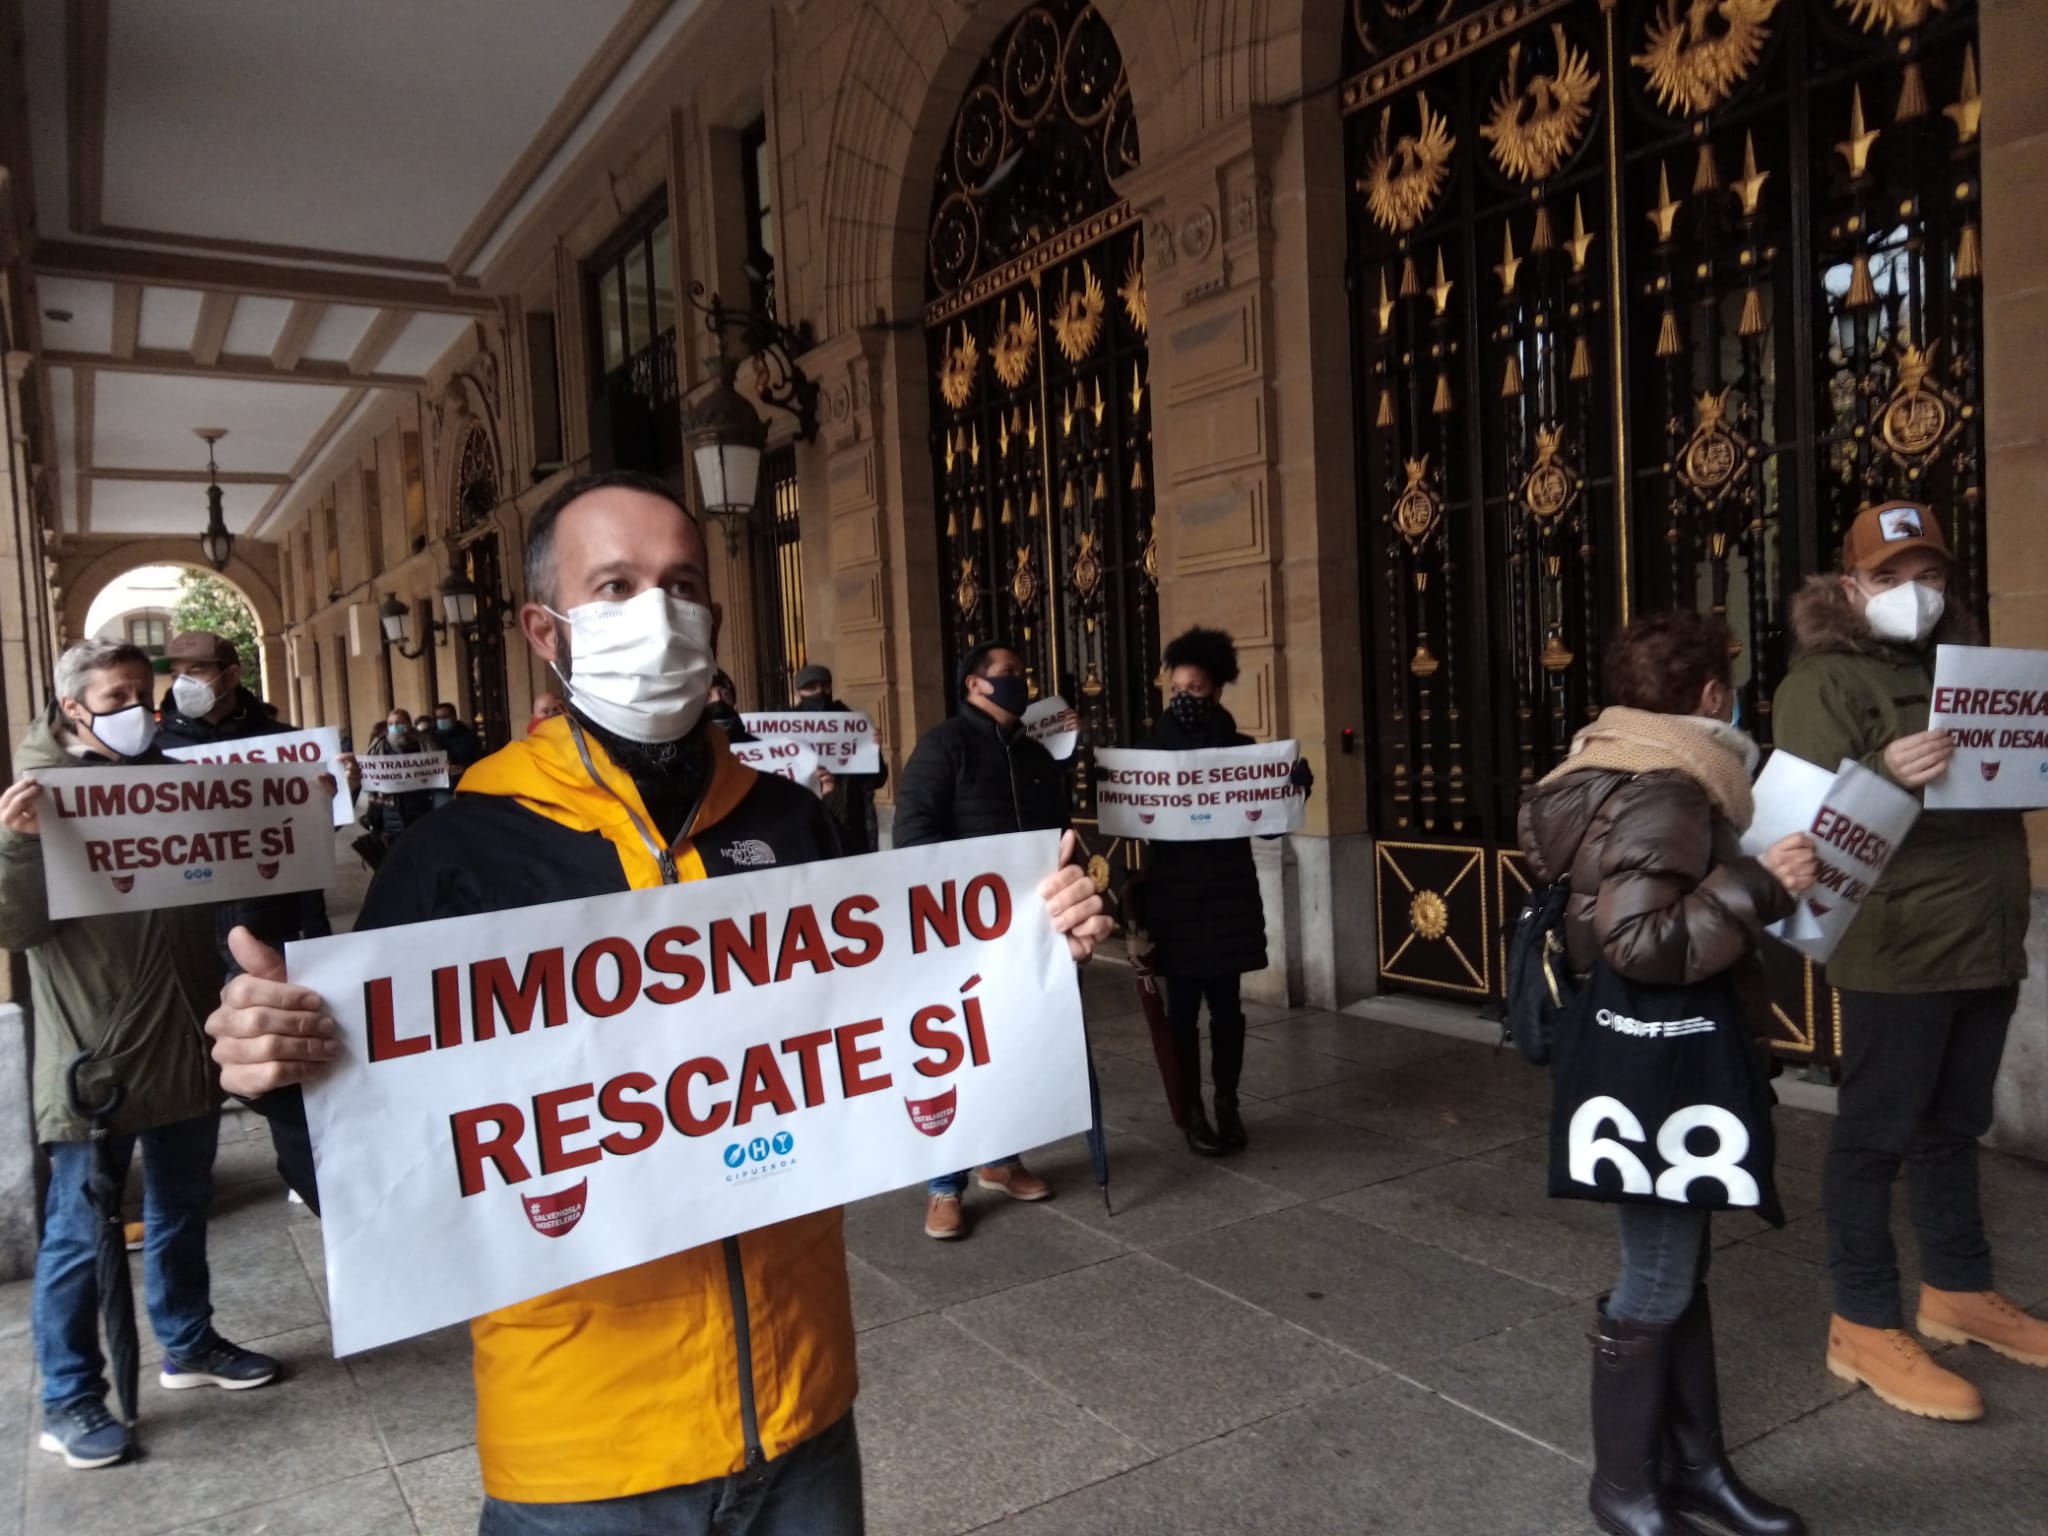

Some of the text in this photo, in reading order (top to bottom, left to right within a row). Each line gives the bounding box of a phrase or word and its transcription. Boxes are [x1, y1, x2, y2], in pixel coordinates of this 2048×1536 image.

[747, 719, 868, 734] LIMOSNAS NO
[841, 738, 857, 755] SÍ
[1947, 728, 1995, 748] ENOK
[277, 741, 321, 763] NO
[769, 743, 800, 758] NO
[1108, 769, 1170, 786] ECTOR
[1177, 770, 1203, 786] DE
[52, 776, 309, 818] LIMOSNAS NO
[1099, 790, 1192, 807] IMPUESTOS
[1198, 792, 1220, 805] DE
[85, 818, 294, 873] RESCATE SÍ
[364, 872, 1012, 1063] LIMOSNAS NO
[449, 973, 991, 1198] RESCATE SÍ
[1569, 1096, 1760, 1206] 68
[726, 1158, 797, 1182] GIPUZKOA
